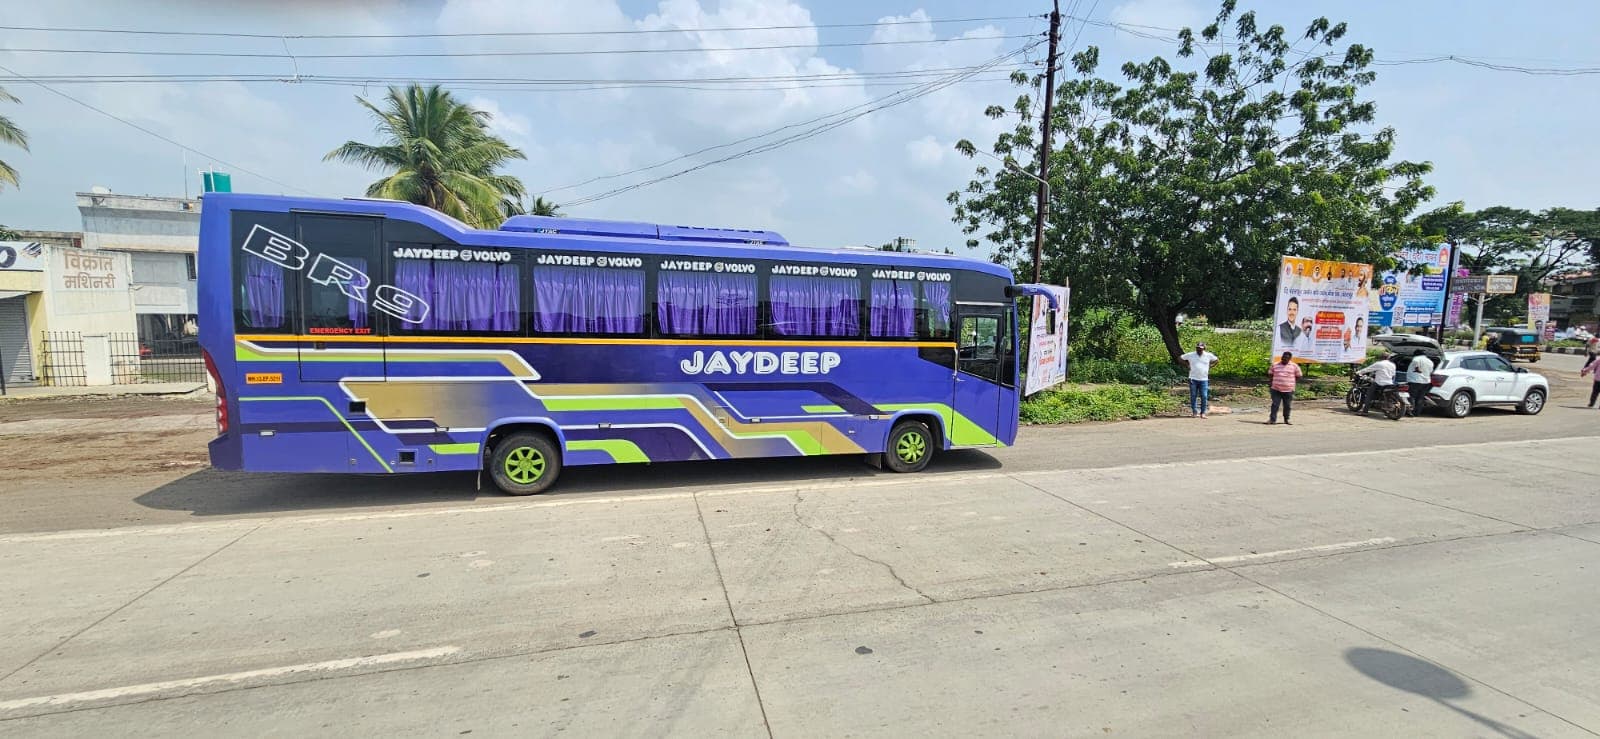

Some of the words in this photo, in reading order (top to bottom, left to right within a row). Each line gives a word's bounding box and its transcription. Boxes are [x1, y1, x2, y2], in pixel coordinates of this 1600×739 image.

[393, 248, 459, 260] JAYDEEP
[473, 251, 511, 262] VOLVO
[537, 254, 595, 266] JAYDEEP
[608, 257, 642, 268] VOLVO
[660, 260, 712, 271] JAYDEEP
[725, 263, 756, 273] VOLVO
[771, 265, 819, 275] JAYDEEP
[829, 267, 858, 277] VOLVO
[242, 224, 430, 324] BR9
[872, 269, 915, 280] JAYDEEP
[926, 272, 951, 281] VOLVO
[680, 350, 841, 375] JAYDEEP
